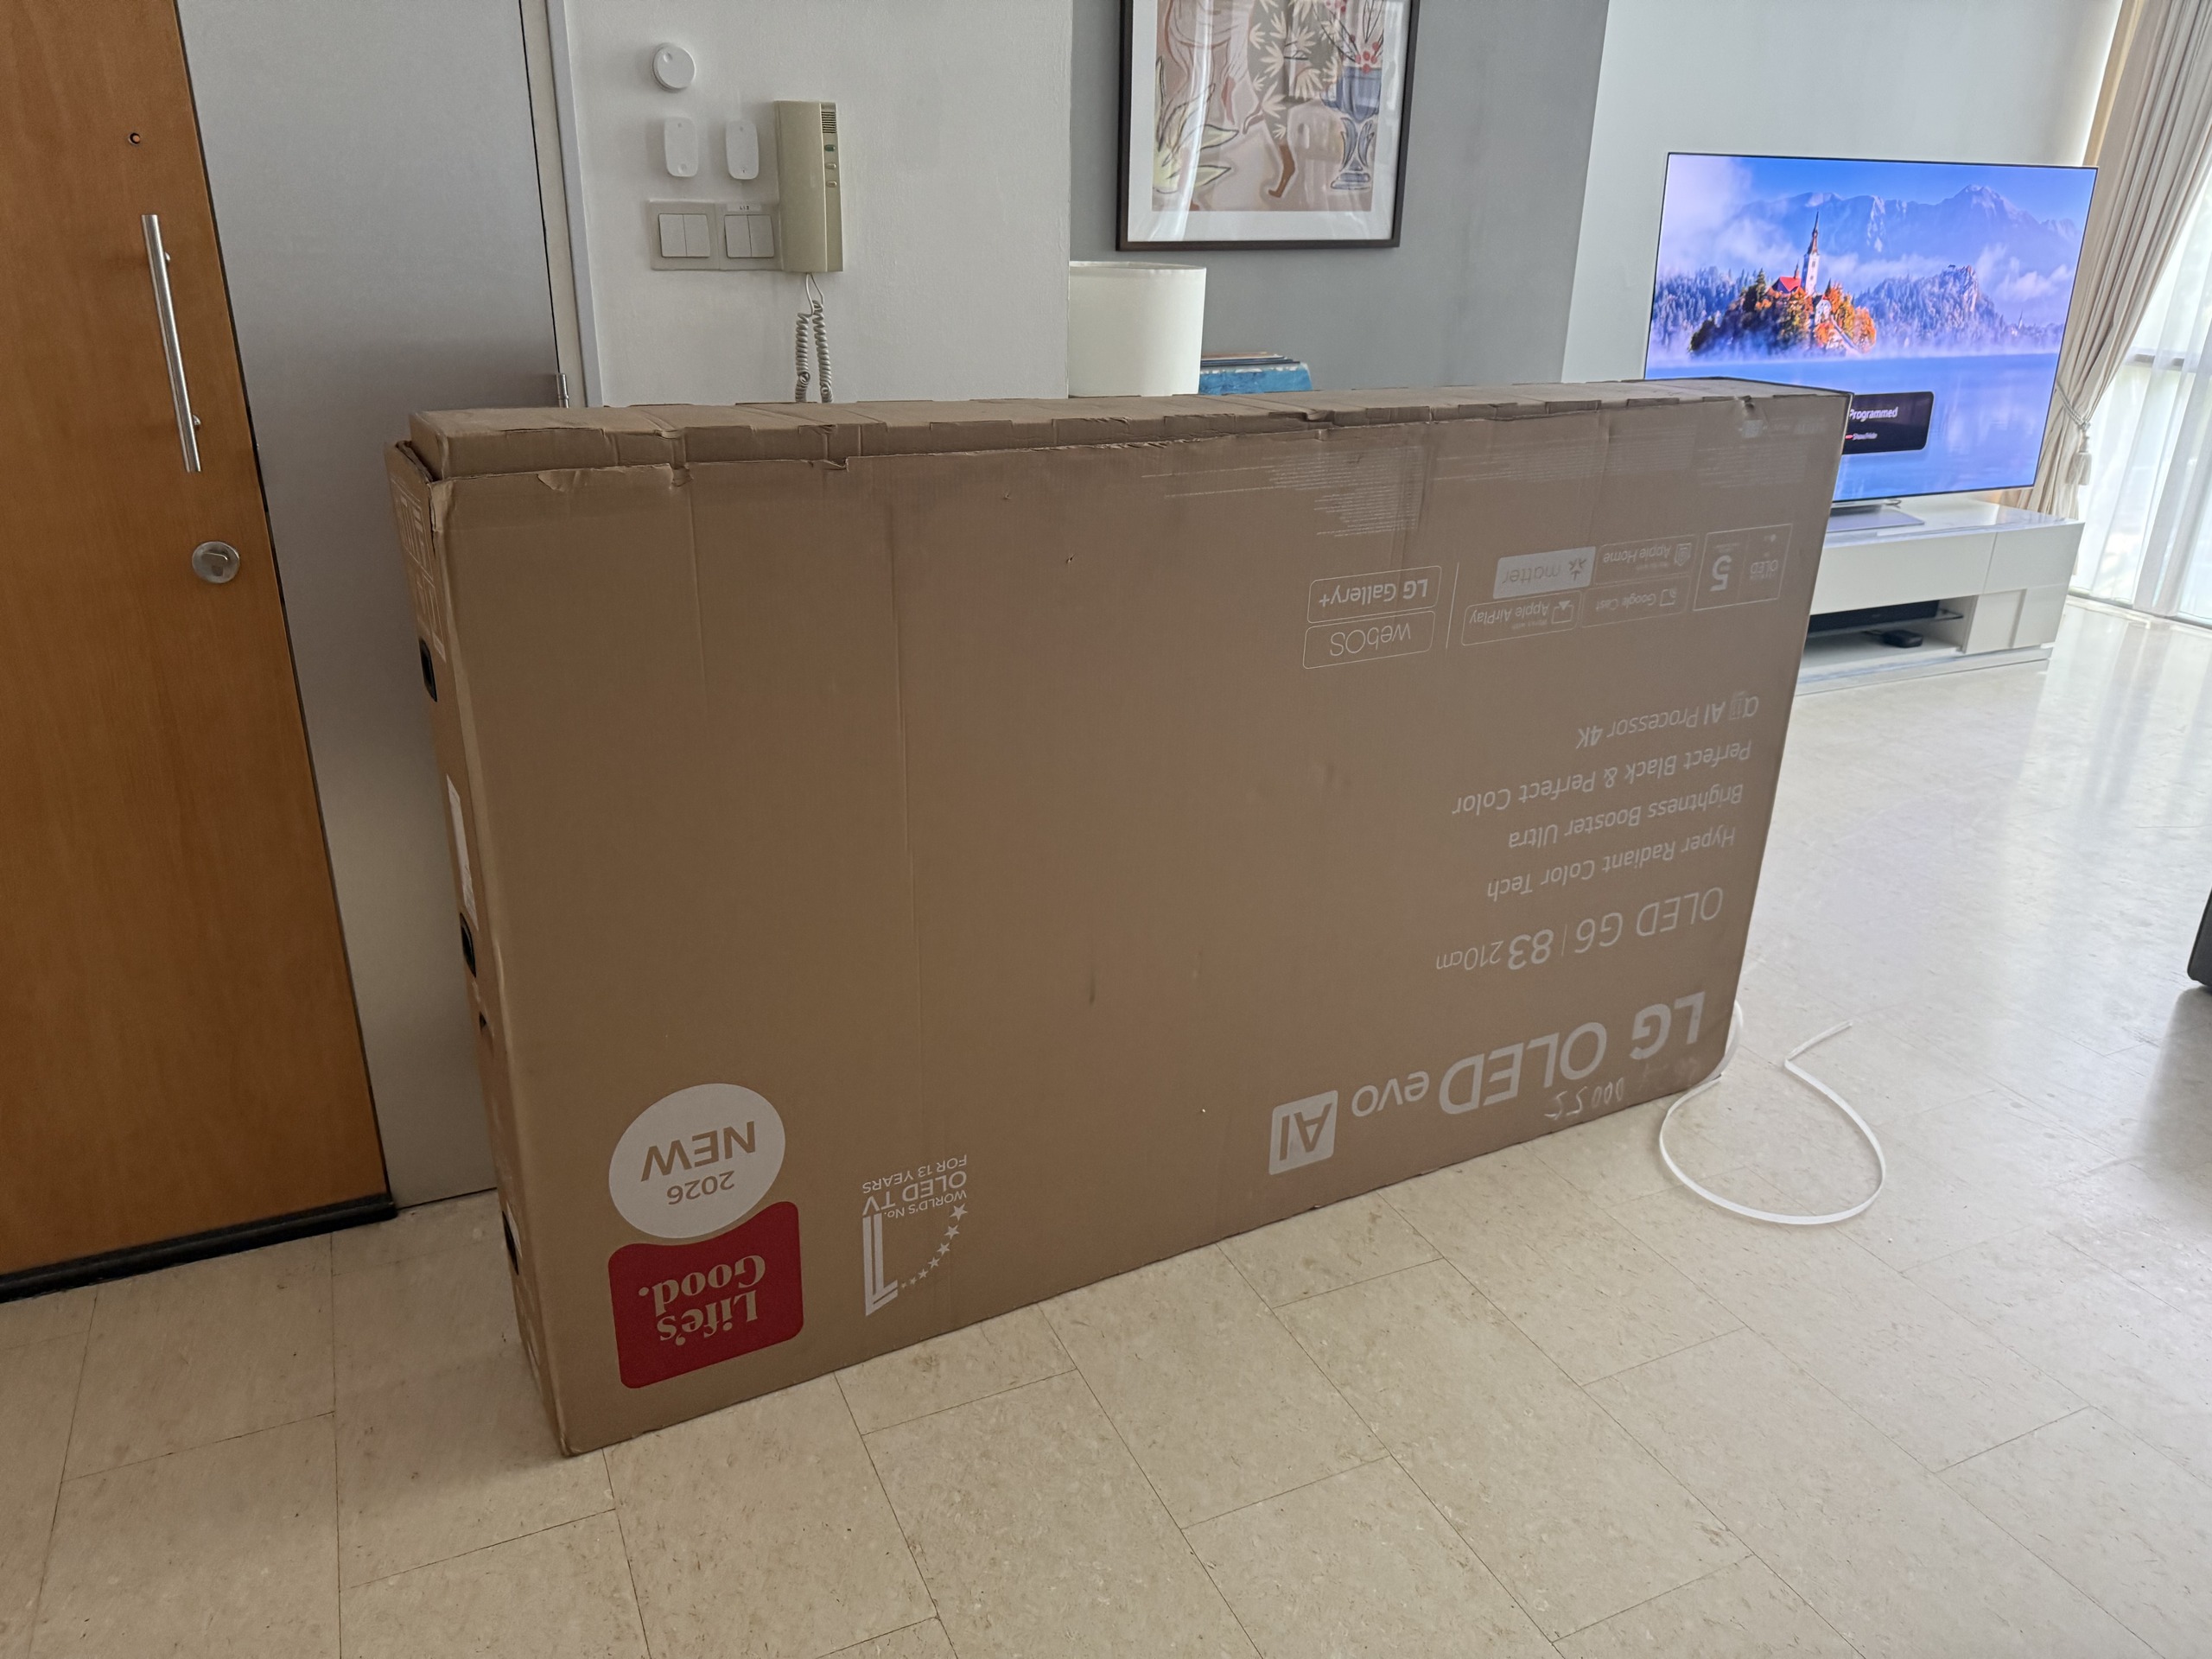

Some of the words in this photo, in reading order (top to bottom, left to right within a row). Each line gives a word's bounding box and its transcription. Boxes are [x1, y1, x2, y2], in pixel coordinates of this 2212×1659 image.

[1603, 549, 1637, 563] Home
[1640, 545, 1672, 558] Apple
[1502, 564, 1561, 583] matter
[1710, 555, 1732, 592] 5
[1750, 560, 1779, 574] OLED
[1319, 583, 1397, 607] Gallery+
[1402, 578, 1428, 600] LG
[1621, 592, 1656, 608] Google
[1469, 608, 1512, 626] AirPlay
[1515, 601, 1550, 619] Apple
[1596, 598, 1619, 612] Cast
[1330, 623, 1411, 657] webOS
[1606, 709, 1699, 738] Processor
[1703, 701, 1726, 724] AI
[1576, 727, 1604, 749] 4K
[1625, 753, 1677, 784] Black
[1684, 740, 1751, 769] Perfect
[1518, 772, 1596, 804] Perfect
[1604, 768, 1618, 789] &
[1452, 789, 1511, 816] Color
[1648, 784, 1744, 818] Brightness
[1565, 805, 1641, 836] Booster
[1509, 824, 1558, 849] Ultra
[1681, 824, 1736, 853] Hyper
[1602, 841, 1676, 873] Radiant
[1488, 874, 1534, 901] Tech
[1541, 860, 1595, 887] Color
[1637, 887, 1724, 937] OLED
[1575, 912, 1624, 954] G6
[1436, 940, 1503, 970] 210cm
[1508, 929, 1554, 969] 83
[1630, 991, 1706, 1060] LG
[1439, 1021, 1608, 1115] OLED
[1351, 1071, 1430, 1117] evo
[1280, 1102, 1333, 1161] AI
[640, 1121, 756, 1182] NEW
[937, 1154, 967, 1173] FOR
[862, 1171, 913, 1194] YEARS
[918, 1164, 933, 1178] 13
[666, 1171, 734, 1205] 2026
[901, 1171, 967, 1202] OLED
[862, 1191, 896, 1216] TV
[884, 1209, 905, 1218] No.
[908, 1190, 967, 1215] WORLD'S
[638, 1255, 766, 1318] Good.
[656, 1289, 758, 1346] Life's
